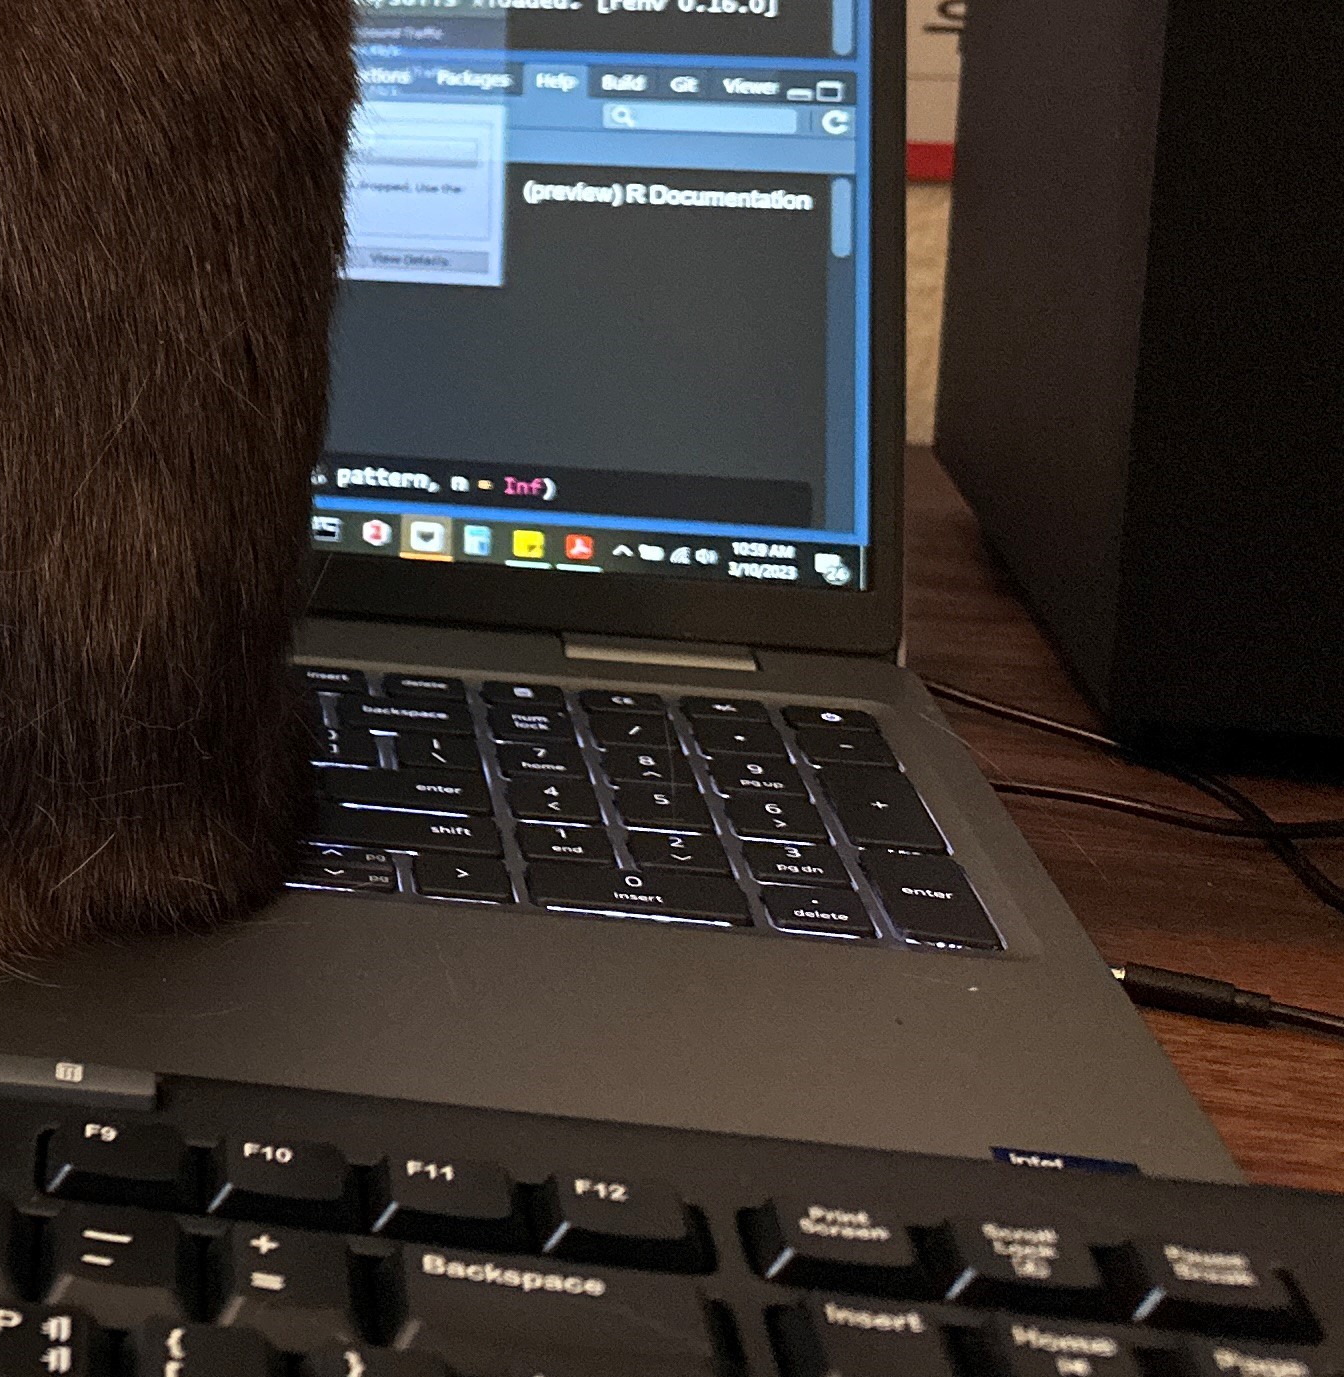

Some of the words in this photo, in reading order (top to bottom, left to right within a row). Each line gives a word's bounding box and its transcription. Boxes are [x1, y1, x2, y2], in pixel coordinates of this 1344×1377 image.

[535, 72, 579, 92] Help
[601, 74, 646, 91] Build
[722, 77, 780, 95] Viewer
[523, 180, 624, 206] (preview)
[625, 183, 647, 204] R
[649, 185, 812, 210] Documentation
[414, 782, 464, 796] enter
[430, 825, 472, 837] shift
[901, 887, 953, 900] enter
[793, 909, 849, 921] delete
[84, 1123, 118, 1142] F9
[243, 1142, 293, 1163] F10
[406, 1160, 454, 1181] F11
[574, 1179, 627, 1201] F12
[423, 1254, 605, 1295] Backspace
